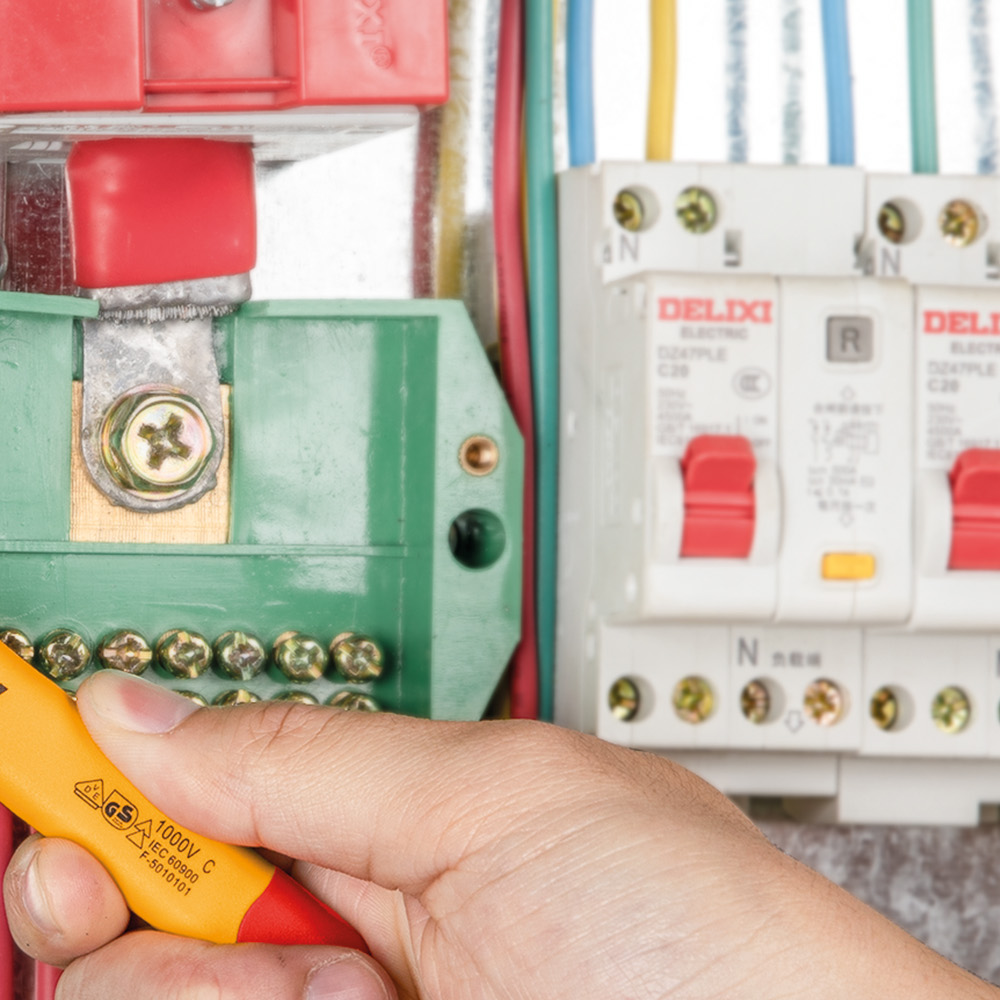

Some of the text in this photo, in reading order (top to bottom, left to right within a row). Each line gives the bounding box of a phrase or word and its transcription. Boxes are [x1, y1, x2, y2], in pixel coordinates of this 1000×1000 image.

[619, 233, 639, 261] N
[881, 248, 901, 276] N
[657, 297, 773, 324] DELIXI
[680, 326, 749, 340] ELECTRIC
[841, 327, 860, 353] R
[738, 637, 758, 667] N
[104, 802, 134, 823] GS
[155, 820, 201, 859] 1000V
[202, 859, 216, 874] C
[139, 850, 191, 897] F-5010101
[148, 840, 199, 884] IEC 60900
